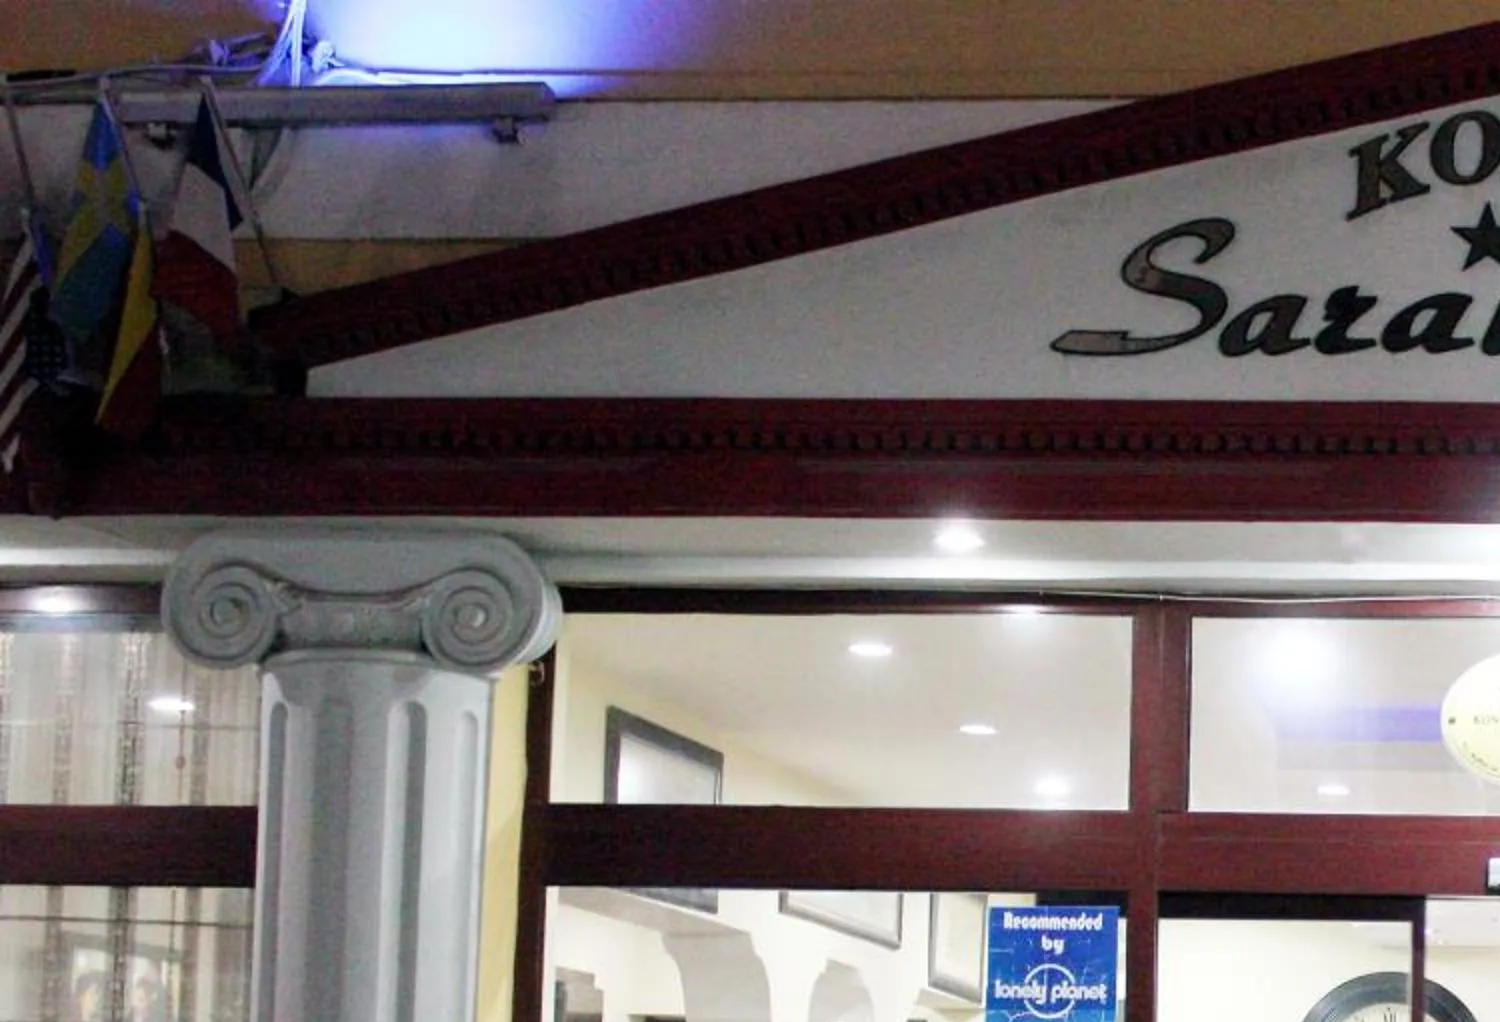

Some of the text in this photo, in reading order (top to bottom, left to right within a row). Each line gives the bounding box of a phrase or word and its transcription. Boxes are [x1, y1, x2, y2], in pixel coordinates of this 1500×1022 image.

[1003, 911, 1103, 931] Recommended
[1041, 935, 1064, 955] by
[995, 979, 1107, 1004] lonely planet
